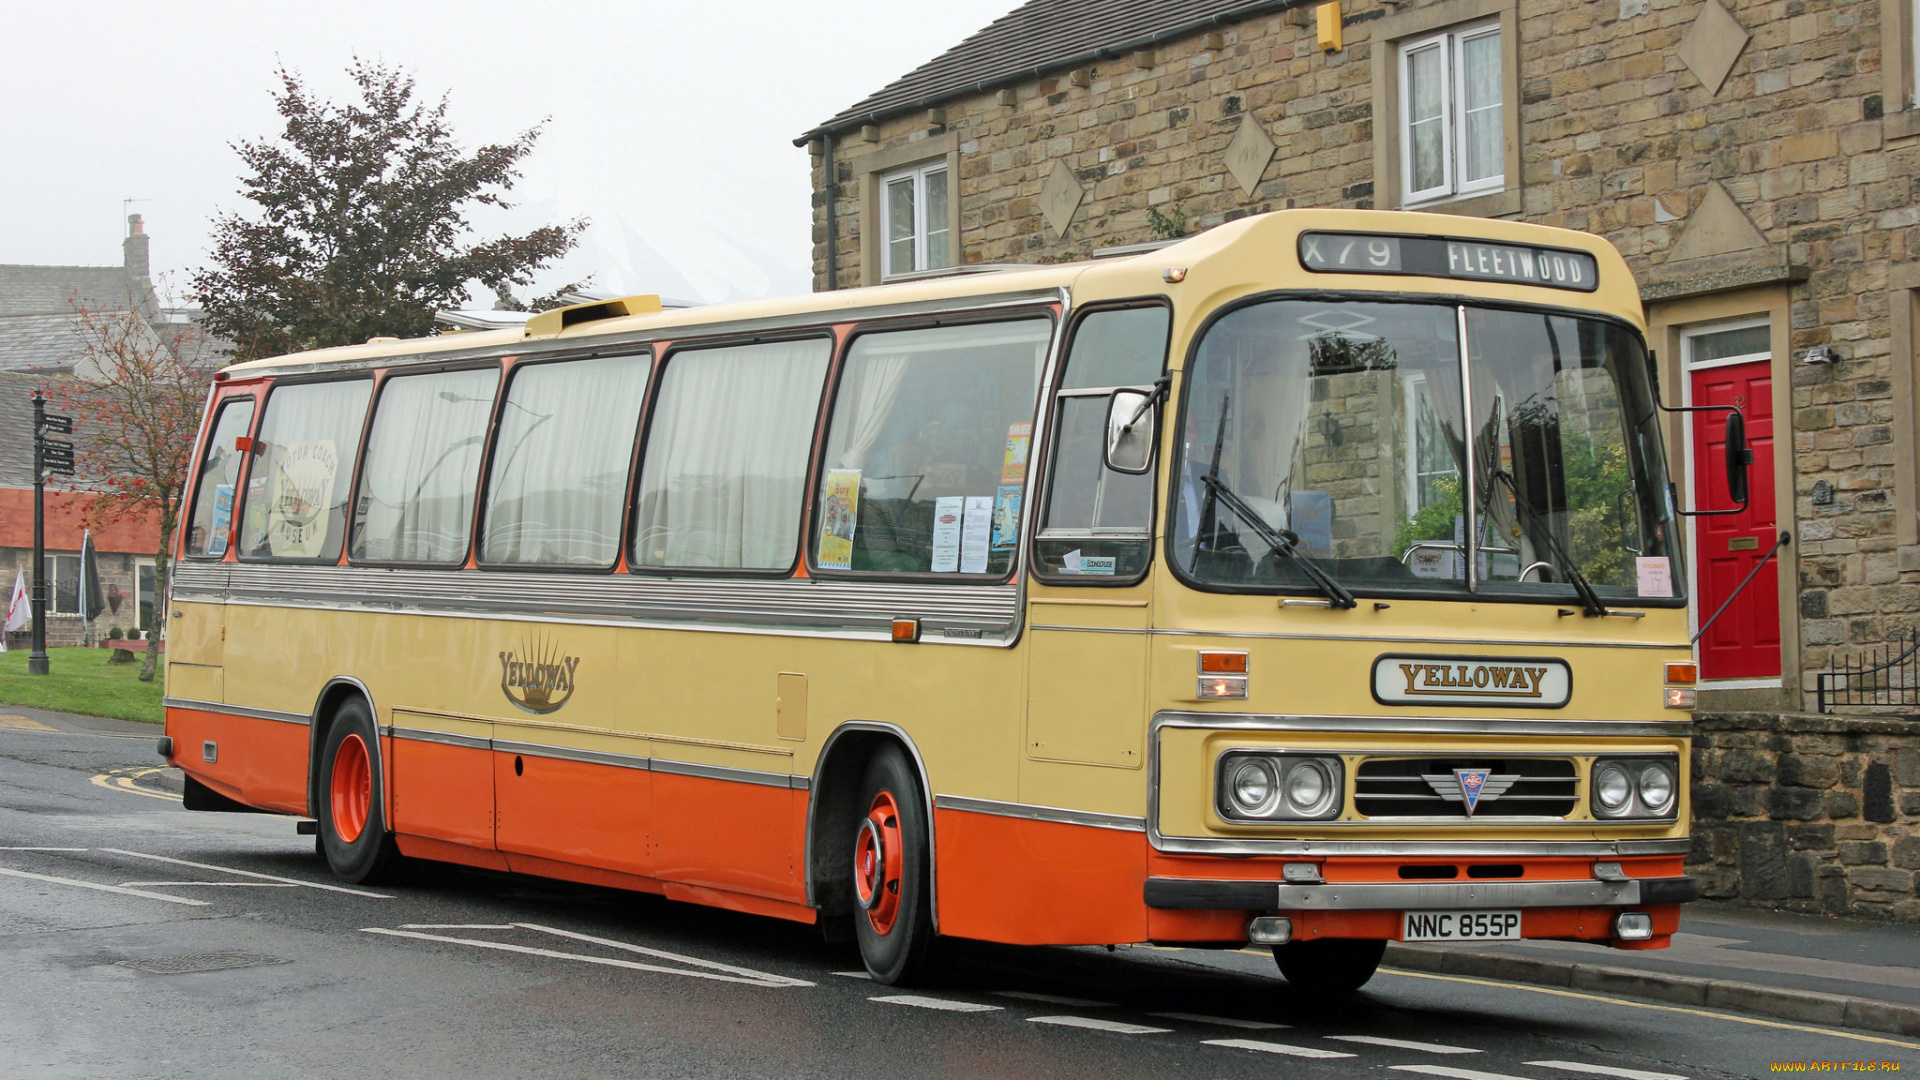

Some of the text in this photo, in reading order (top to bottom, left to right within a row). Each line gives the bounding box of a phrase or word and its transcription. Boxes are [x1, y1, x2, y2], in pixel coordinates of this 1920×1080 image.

[1304, 237, 1583, 283] X79 FLEETWOOD
[499, 651, 580, 700] YELLOWAY
[1399, 664, 1548, 697] YELLOWAY
[1408, 914, 1518, 937] NNC 855P
